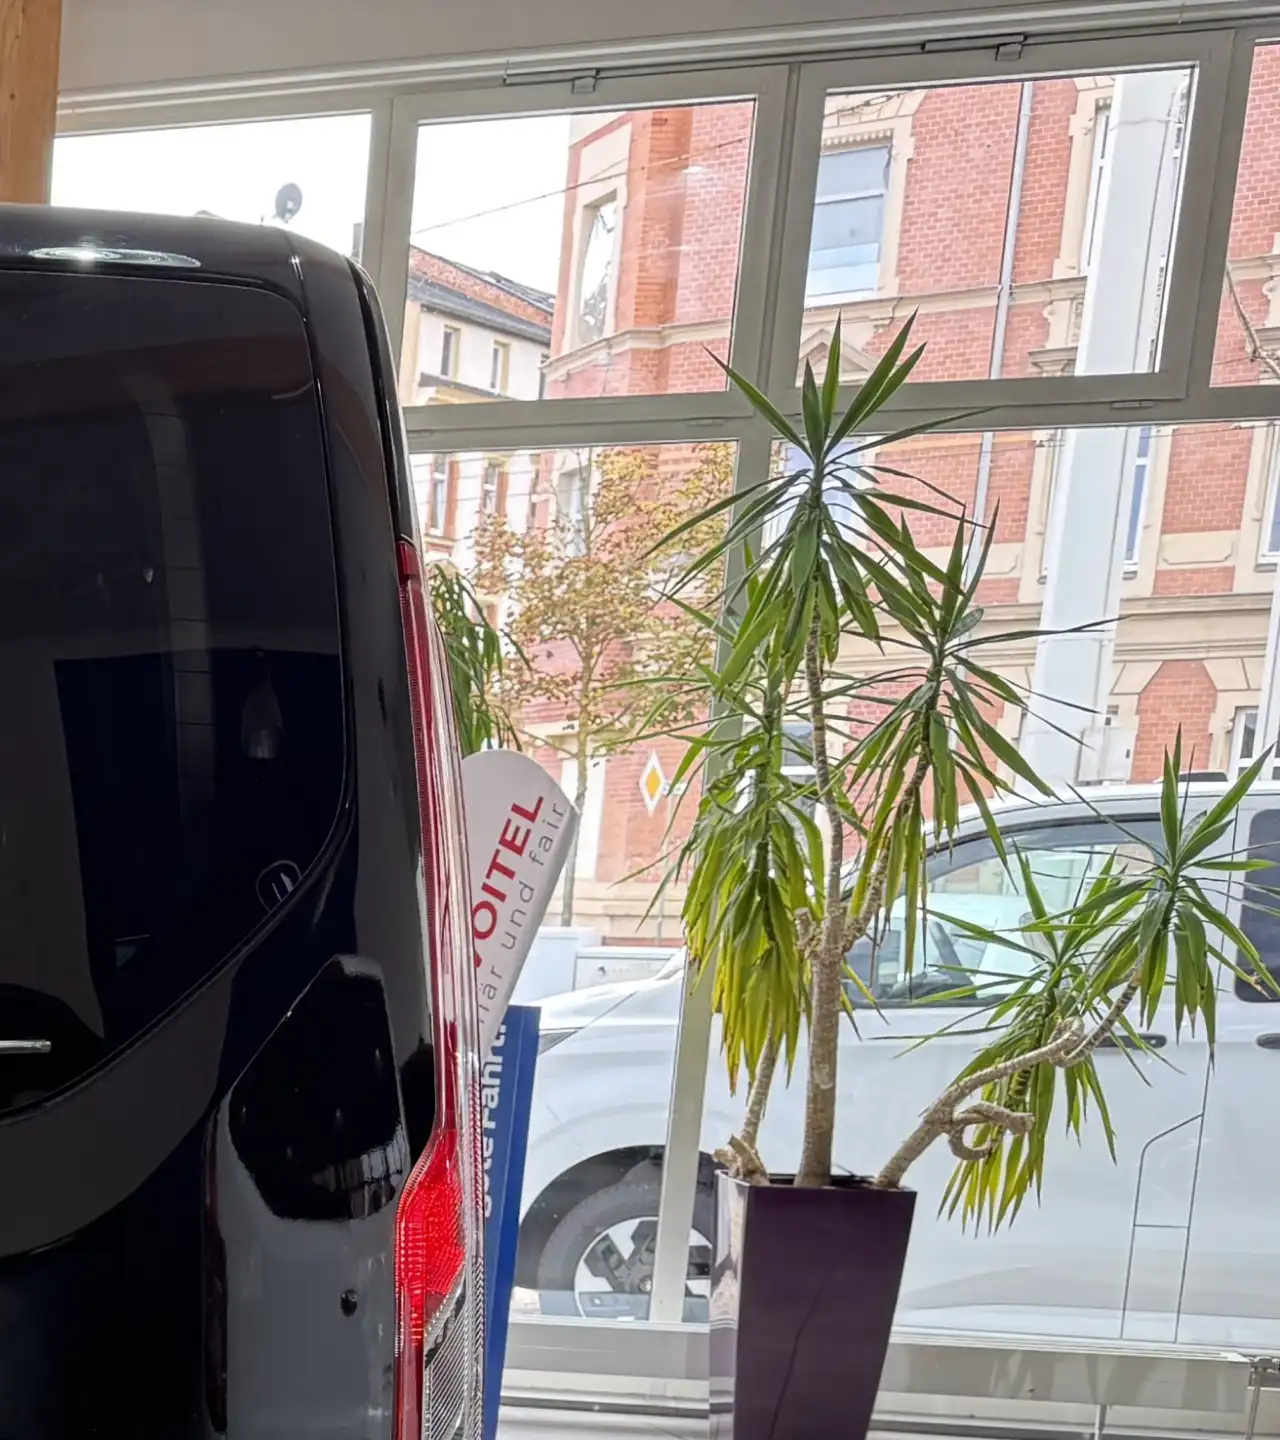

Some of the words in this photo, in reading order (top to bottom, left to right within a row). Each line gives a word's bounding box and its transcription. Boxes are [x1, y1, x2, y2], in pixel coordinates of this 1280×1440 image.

[472, 796, 544, 969] OITEL
[500, 881, 534, 950] und
[529, 803, 564, 865] fair
